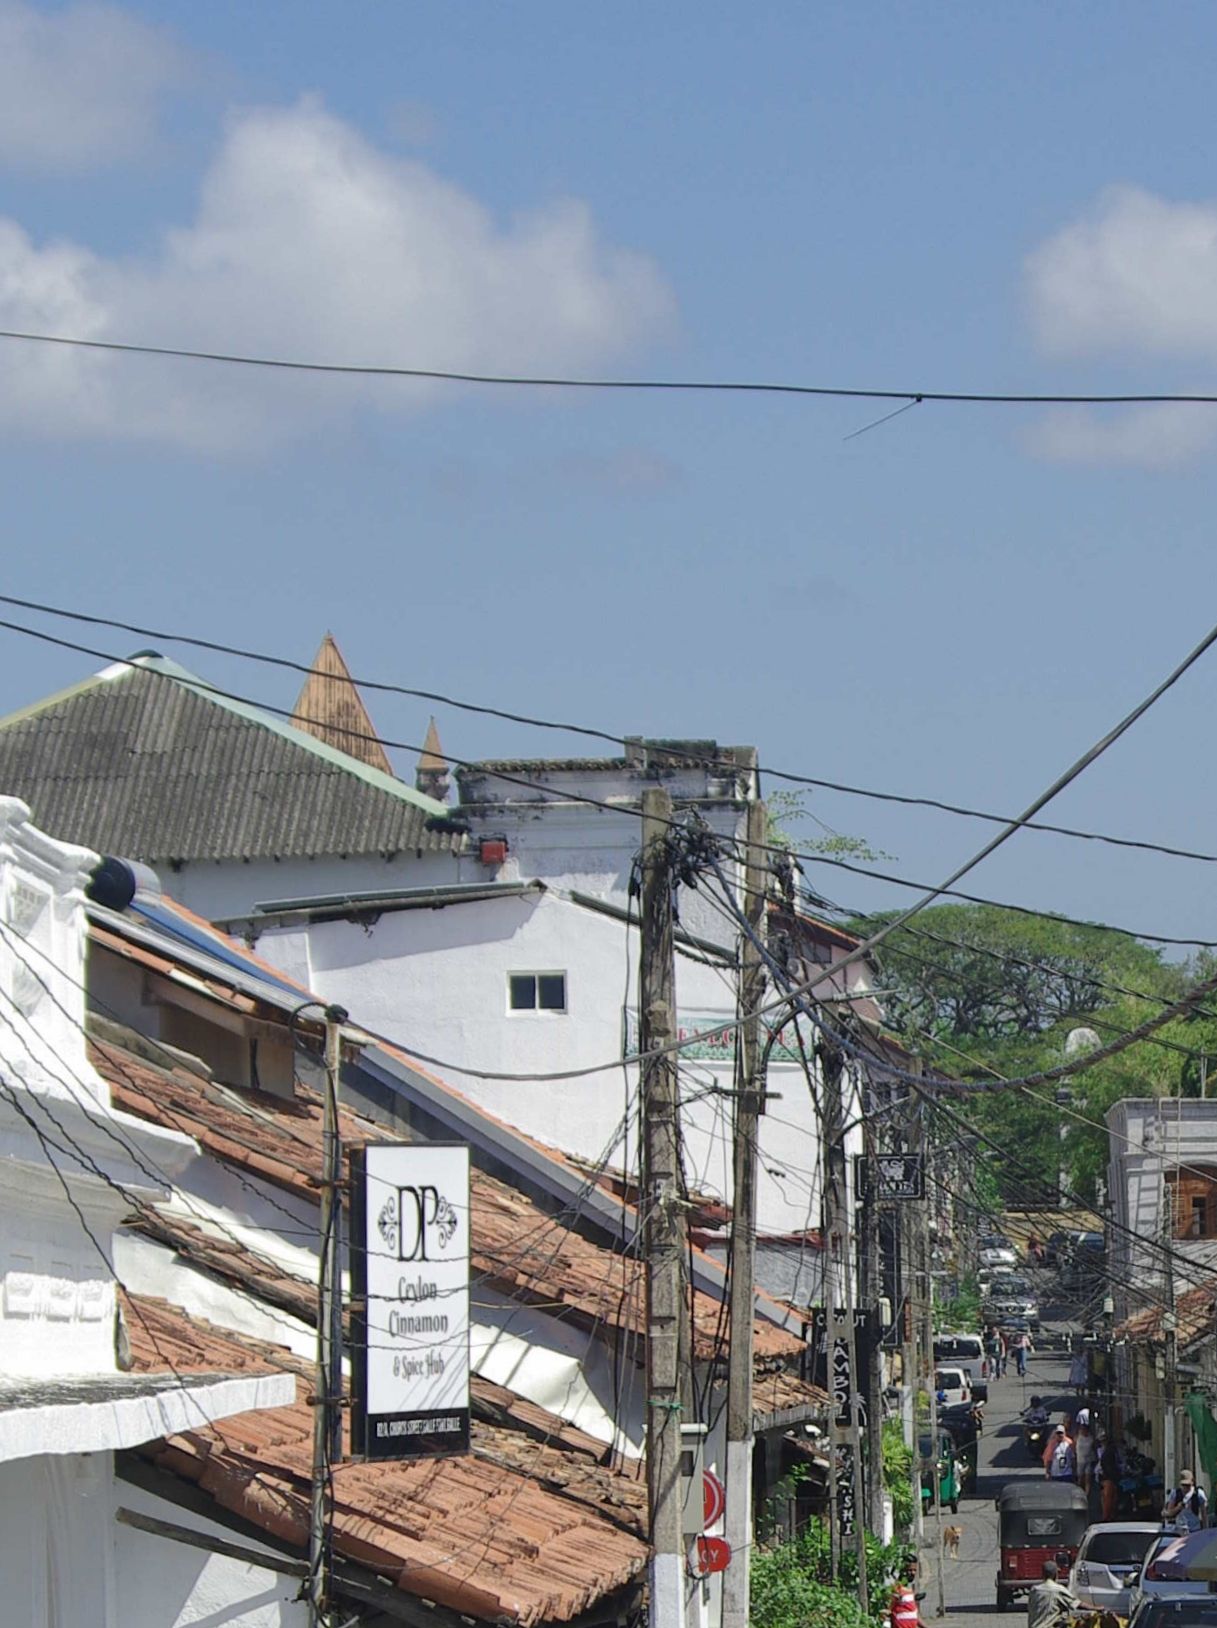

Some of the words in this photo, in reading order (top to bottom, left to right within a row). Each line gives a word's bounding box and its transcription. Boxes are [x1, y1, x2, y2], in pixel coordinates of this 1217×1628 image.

[398, 1275, 437, 1307] Ceylon
[389, 1310, 448, 1338] Cinnamon
[393, 1356, 400, 1377] &
[402, 1355, 424, 1382] Spice
[425, 1349, 445, 1379] Hub
